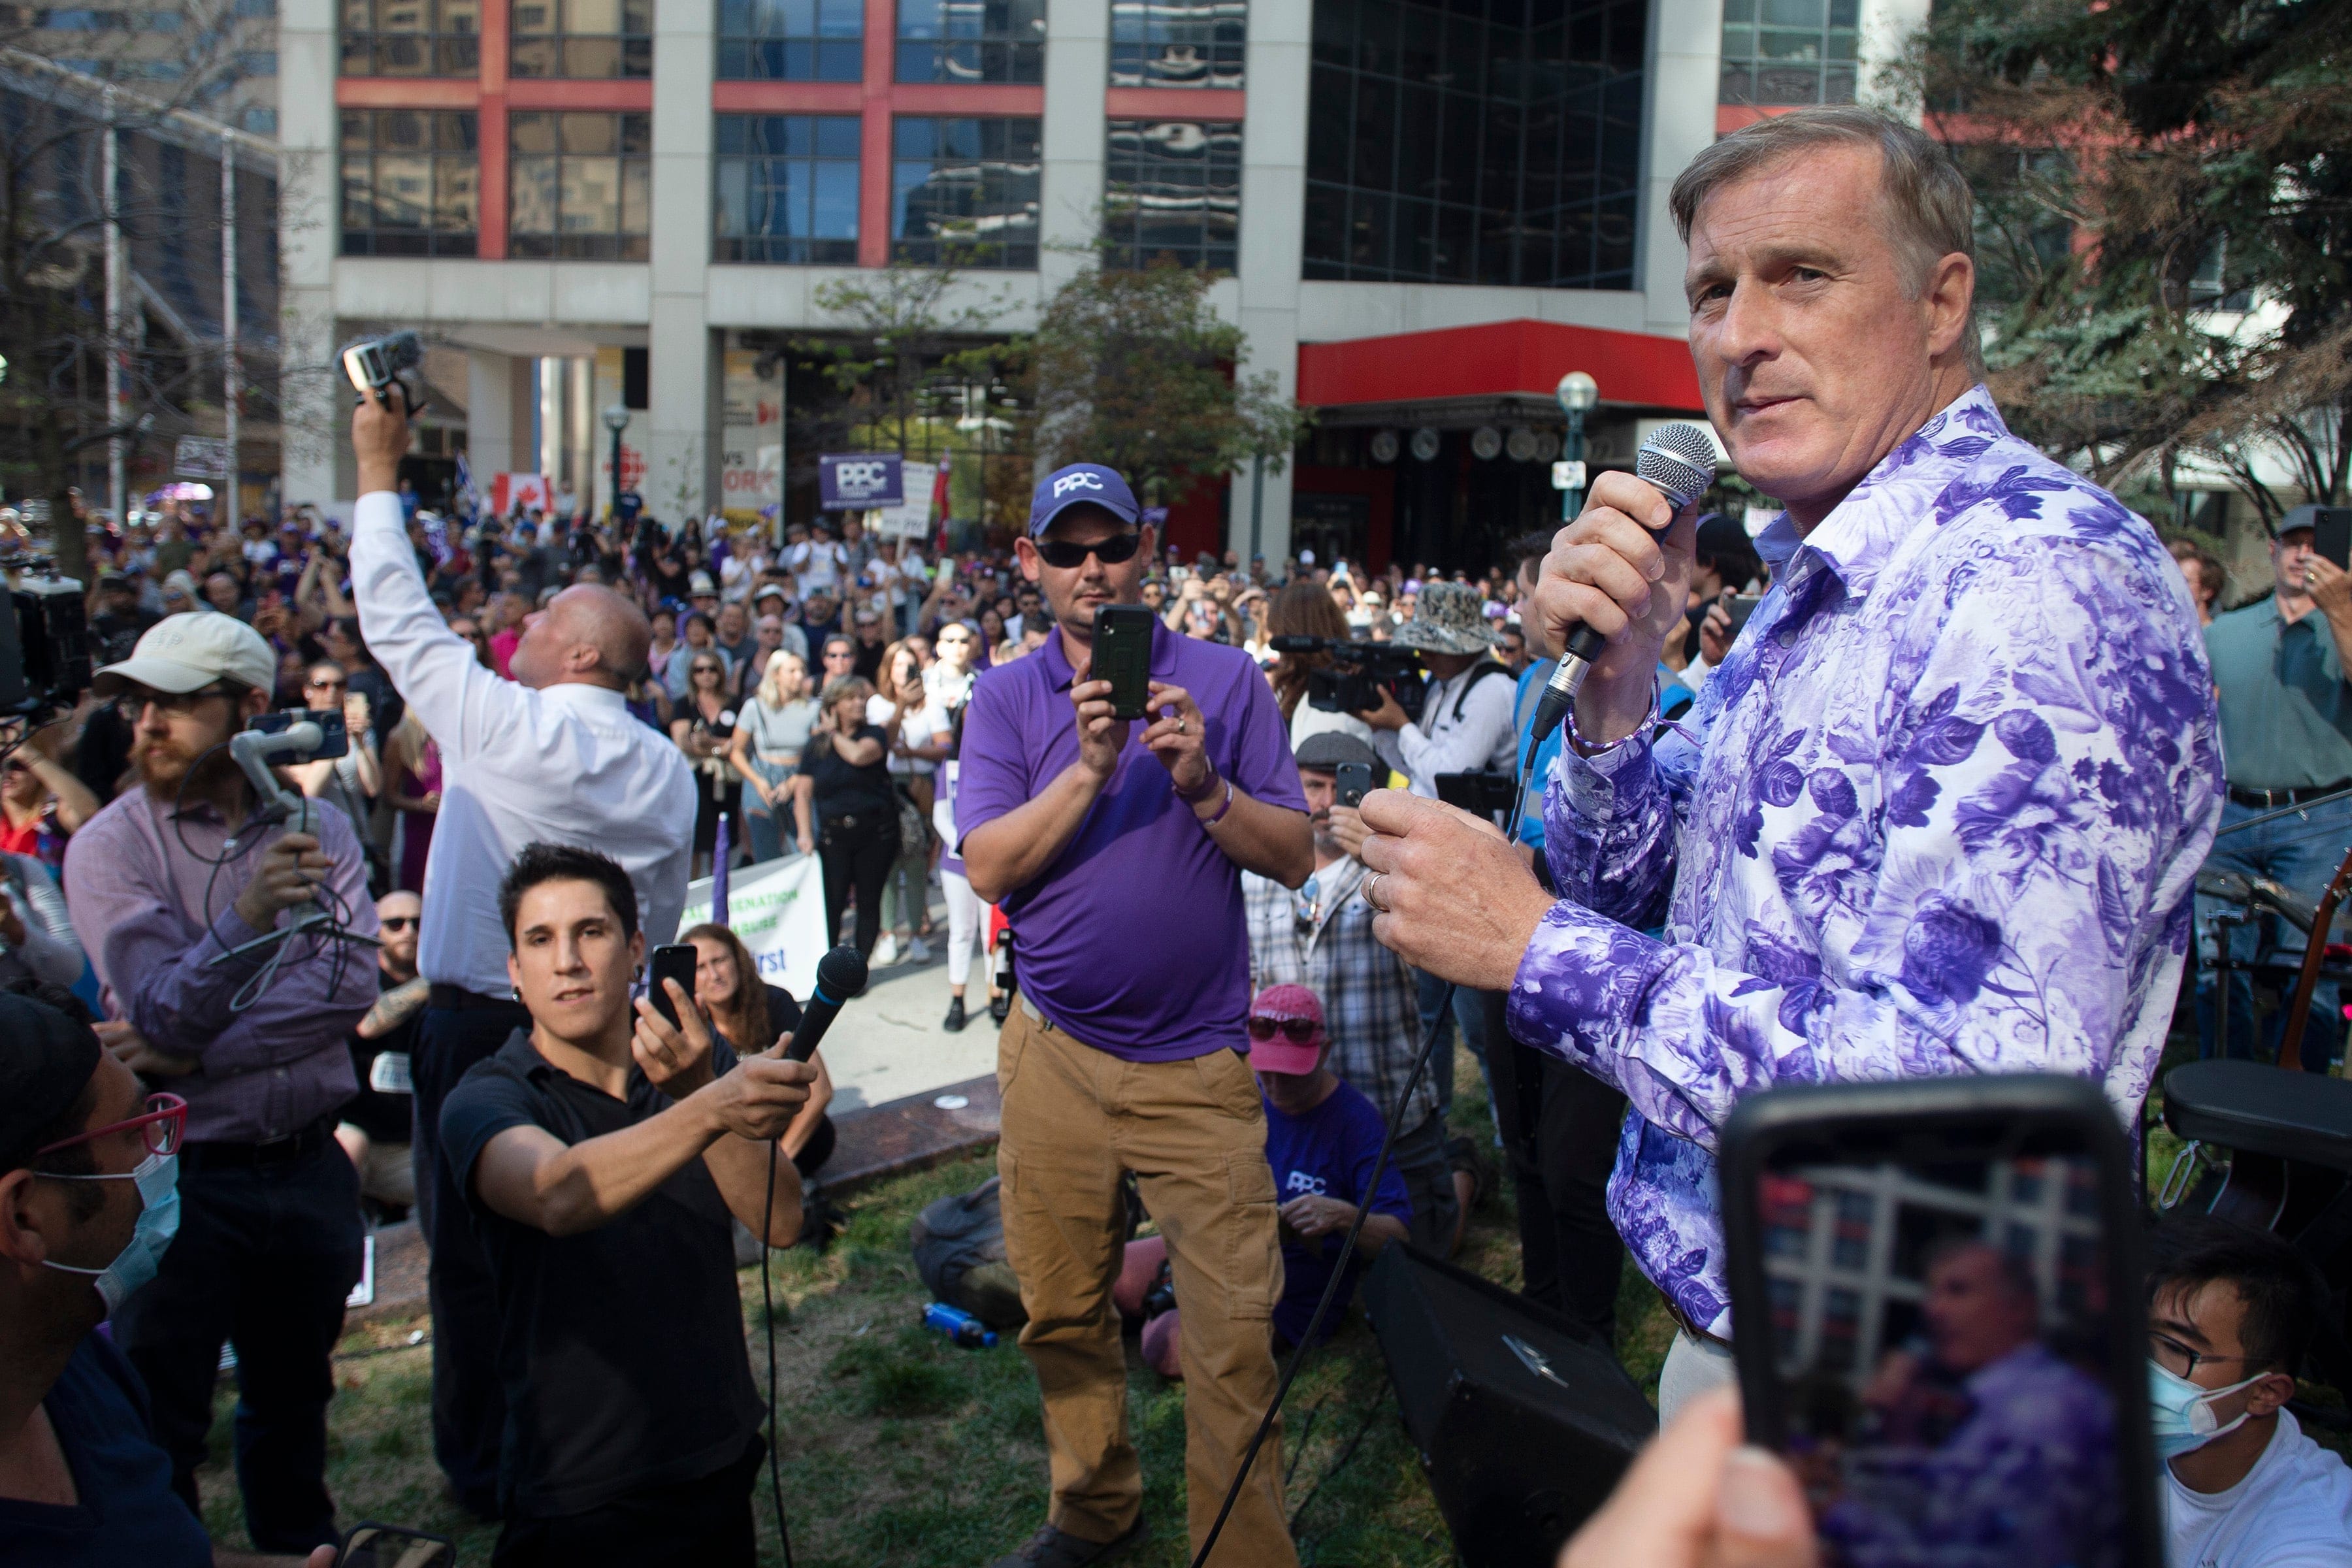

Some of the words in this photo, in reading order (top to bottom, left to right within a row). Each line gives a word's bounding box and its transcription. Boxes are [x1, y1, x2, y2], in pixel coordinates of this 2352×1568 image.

[836, 462, 887, 488] PPC
[1053, 472, 1103, 498] PPC
[756, 949, 786, 973] rst
[1286, 1170, 1326, 1196] PPC
